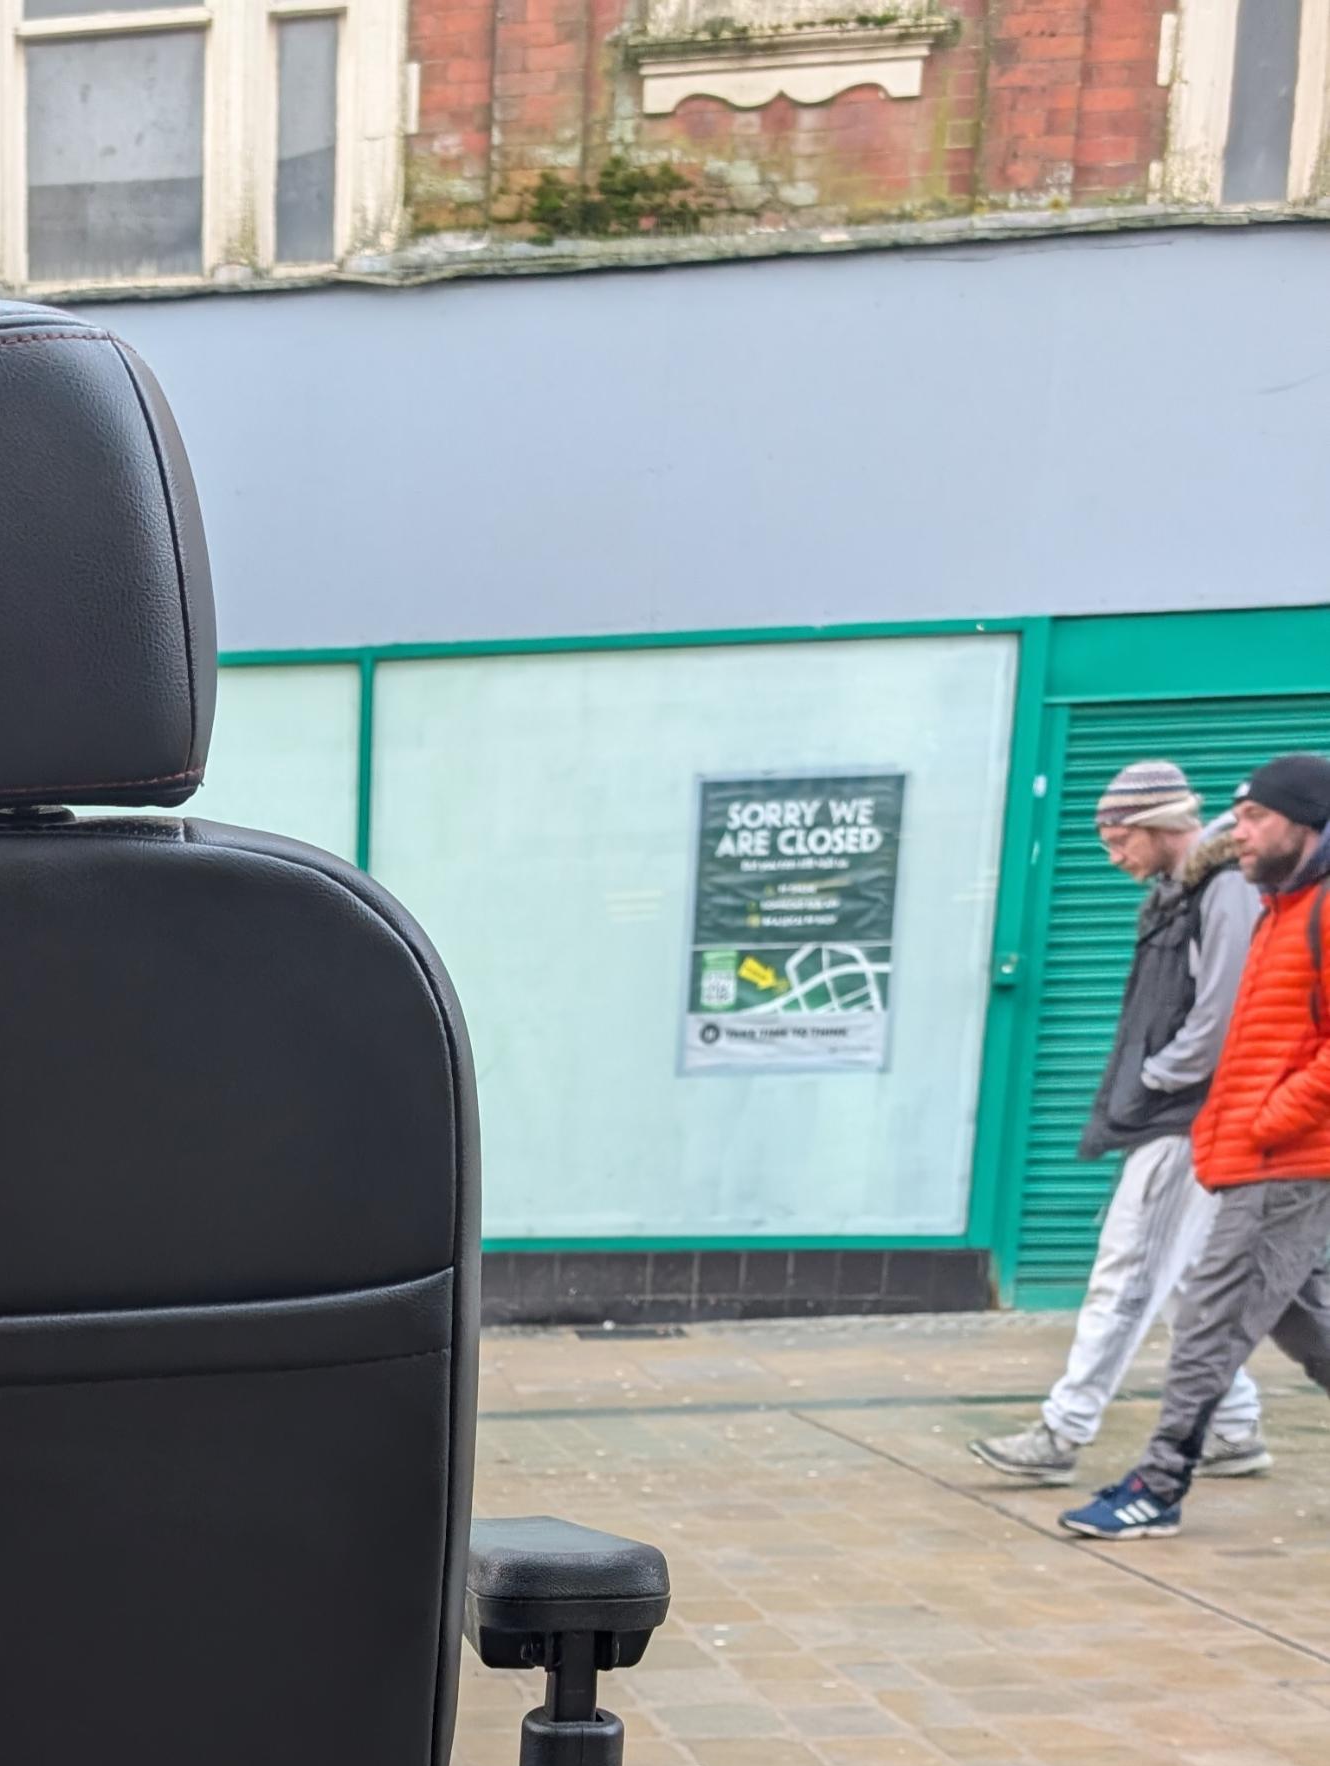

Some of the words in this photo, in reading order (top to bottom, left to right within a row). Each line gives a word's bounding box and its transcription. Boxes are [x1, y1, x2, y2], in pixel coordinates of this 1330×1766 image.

[726, 799, 823, 830] SORRY
[828, 797, 876, 826] WE
[715, 829, 770, 857] ARE
[776, 826, 883, 855] CLOSED
